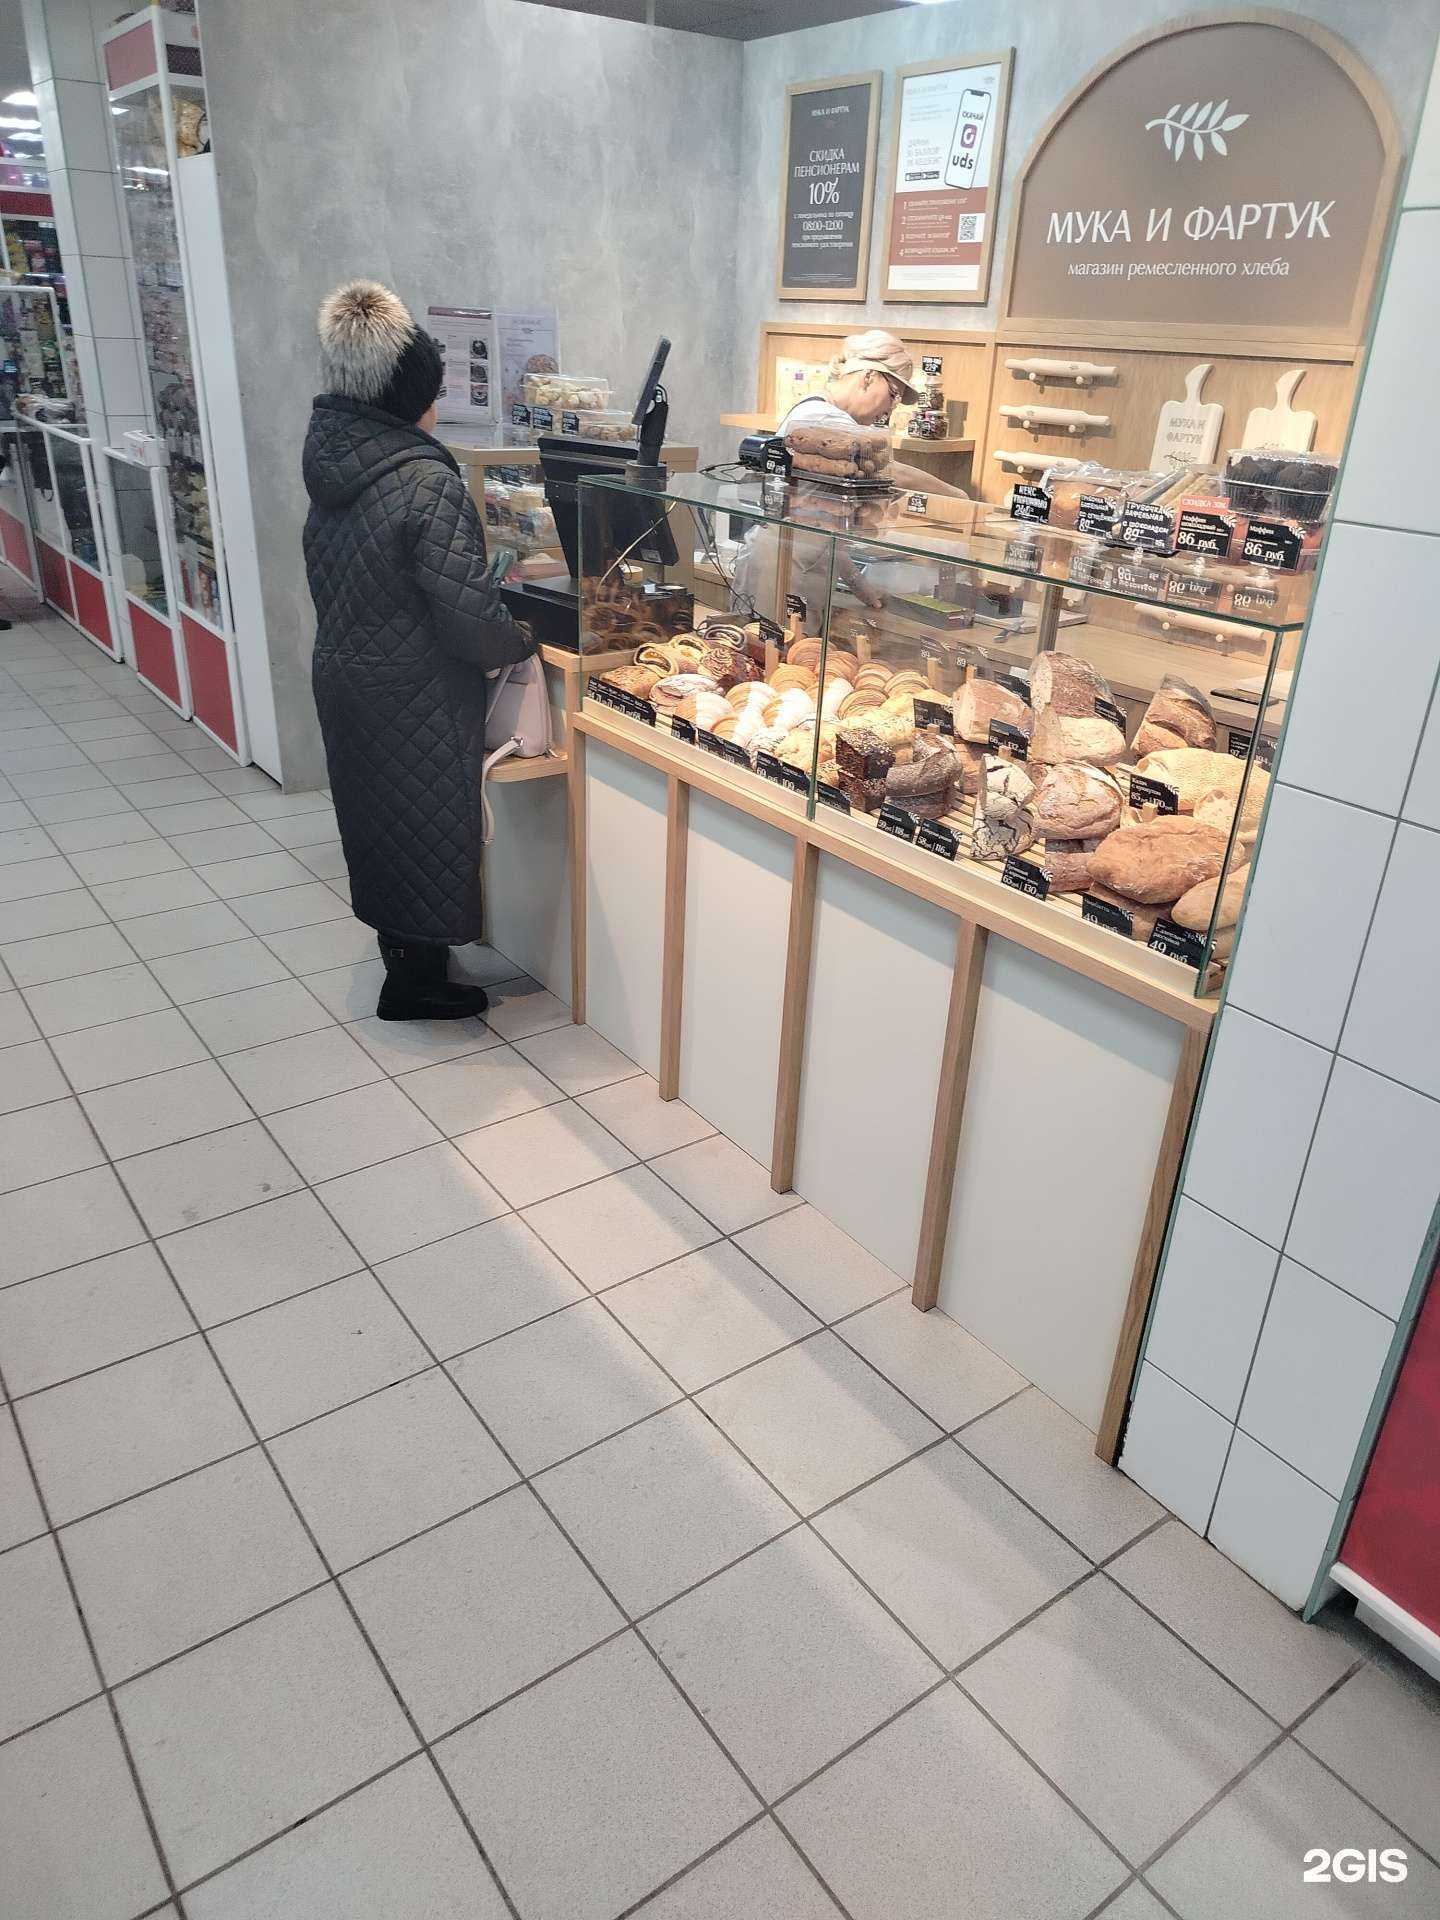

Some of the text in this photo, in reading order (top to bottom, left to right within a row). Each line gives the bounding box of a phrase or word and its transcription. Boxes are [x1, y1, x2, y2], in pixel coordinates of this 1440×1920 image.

[809, 147, 846, 162] СКИДКА
[952, 152, 974, 170] uds
[794, 161, 860, 178] ПЕНСИОНЕРАМ
[809, 177, 840, 205] 10%
[1046, 200, 1336, 244] МУКА И ФАРТУК
[1067, 257, 1290, 281] магазин ремесленного хлеба
[1126, 501, 1164, 514] ТРУБОЧКА
[1182, 498, 1211, 508] СКИДКА
[1124, 509, 1165, 522] ВАФЕЛЬНАЯ
[1181, 514, 1207, 524] Маффин
[1177, 531, 1196, 546] 86
[1244, 541, 1264, 557] 86
[1131, 791, 1141, 801] 85
[917, 835, 928, 846] 58
[1003, 874, 1013, 885] 65
[1023, 882, 1037, 896] 130
[1149, 940, 1167, 954] 49
